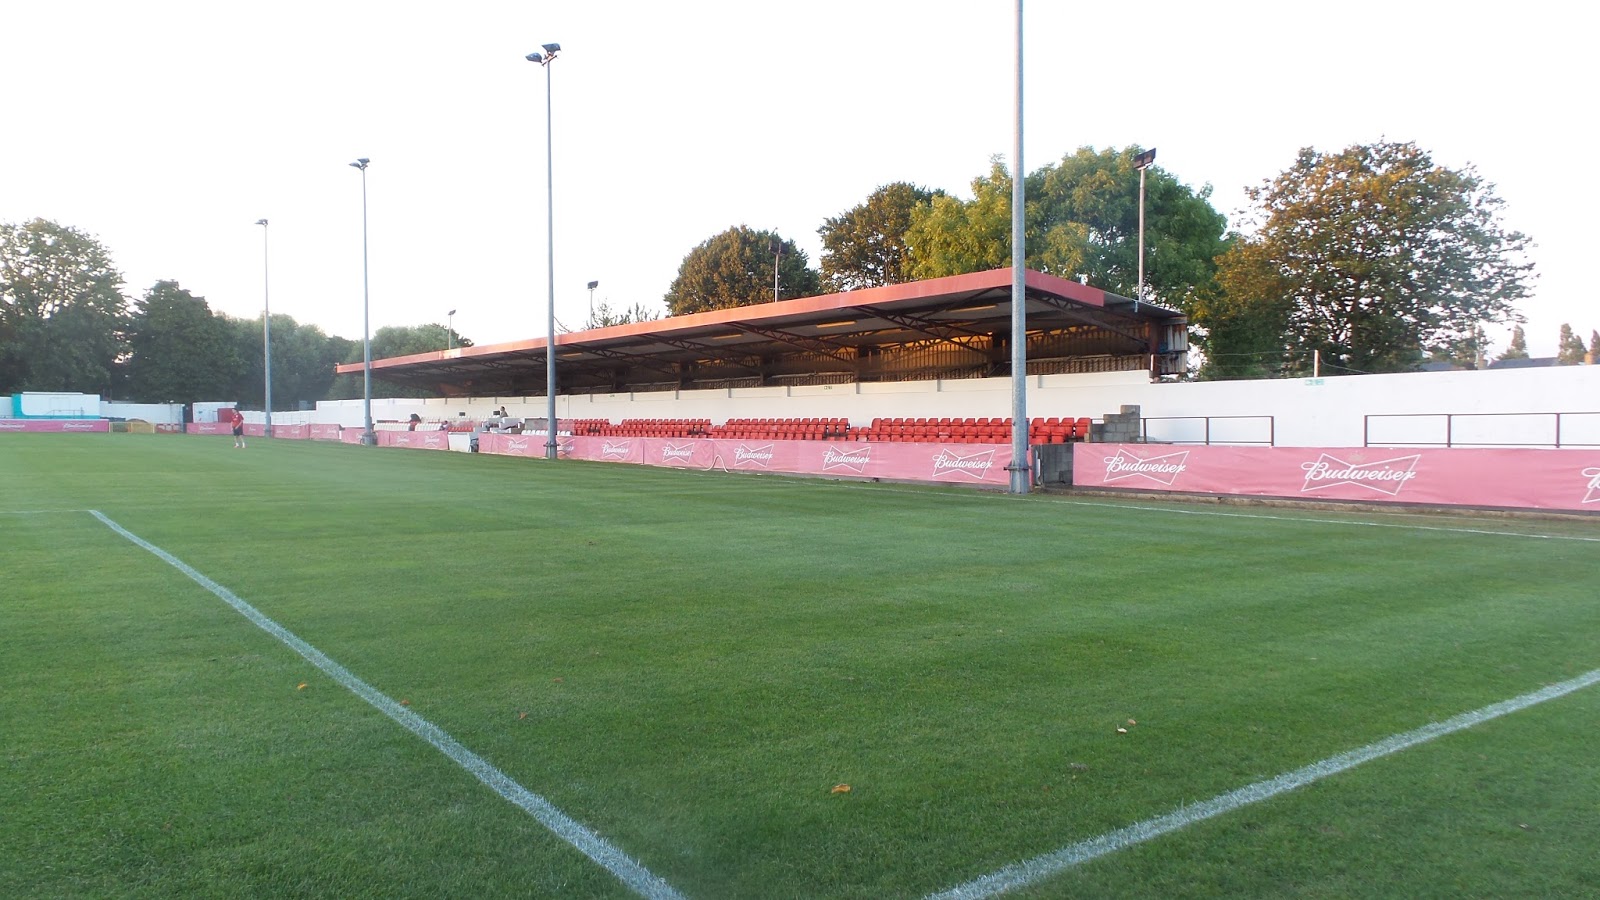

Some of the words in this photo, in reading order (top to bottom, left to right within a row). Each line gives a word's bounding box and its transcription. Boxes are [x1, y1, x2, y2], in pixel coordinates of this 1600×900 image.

[822, 451, 870, 464] Budweiser
[932, 454, 993, 469] Budweiser
[1103, 456, 1187, 474] Budweiser
[1301, 462, 1416, 481] Budweiser
